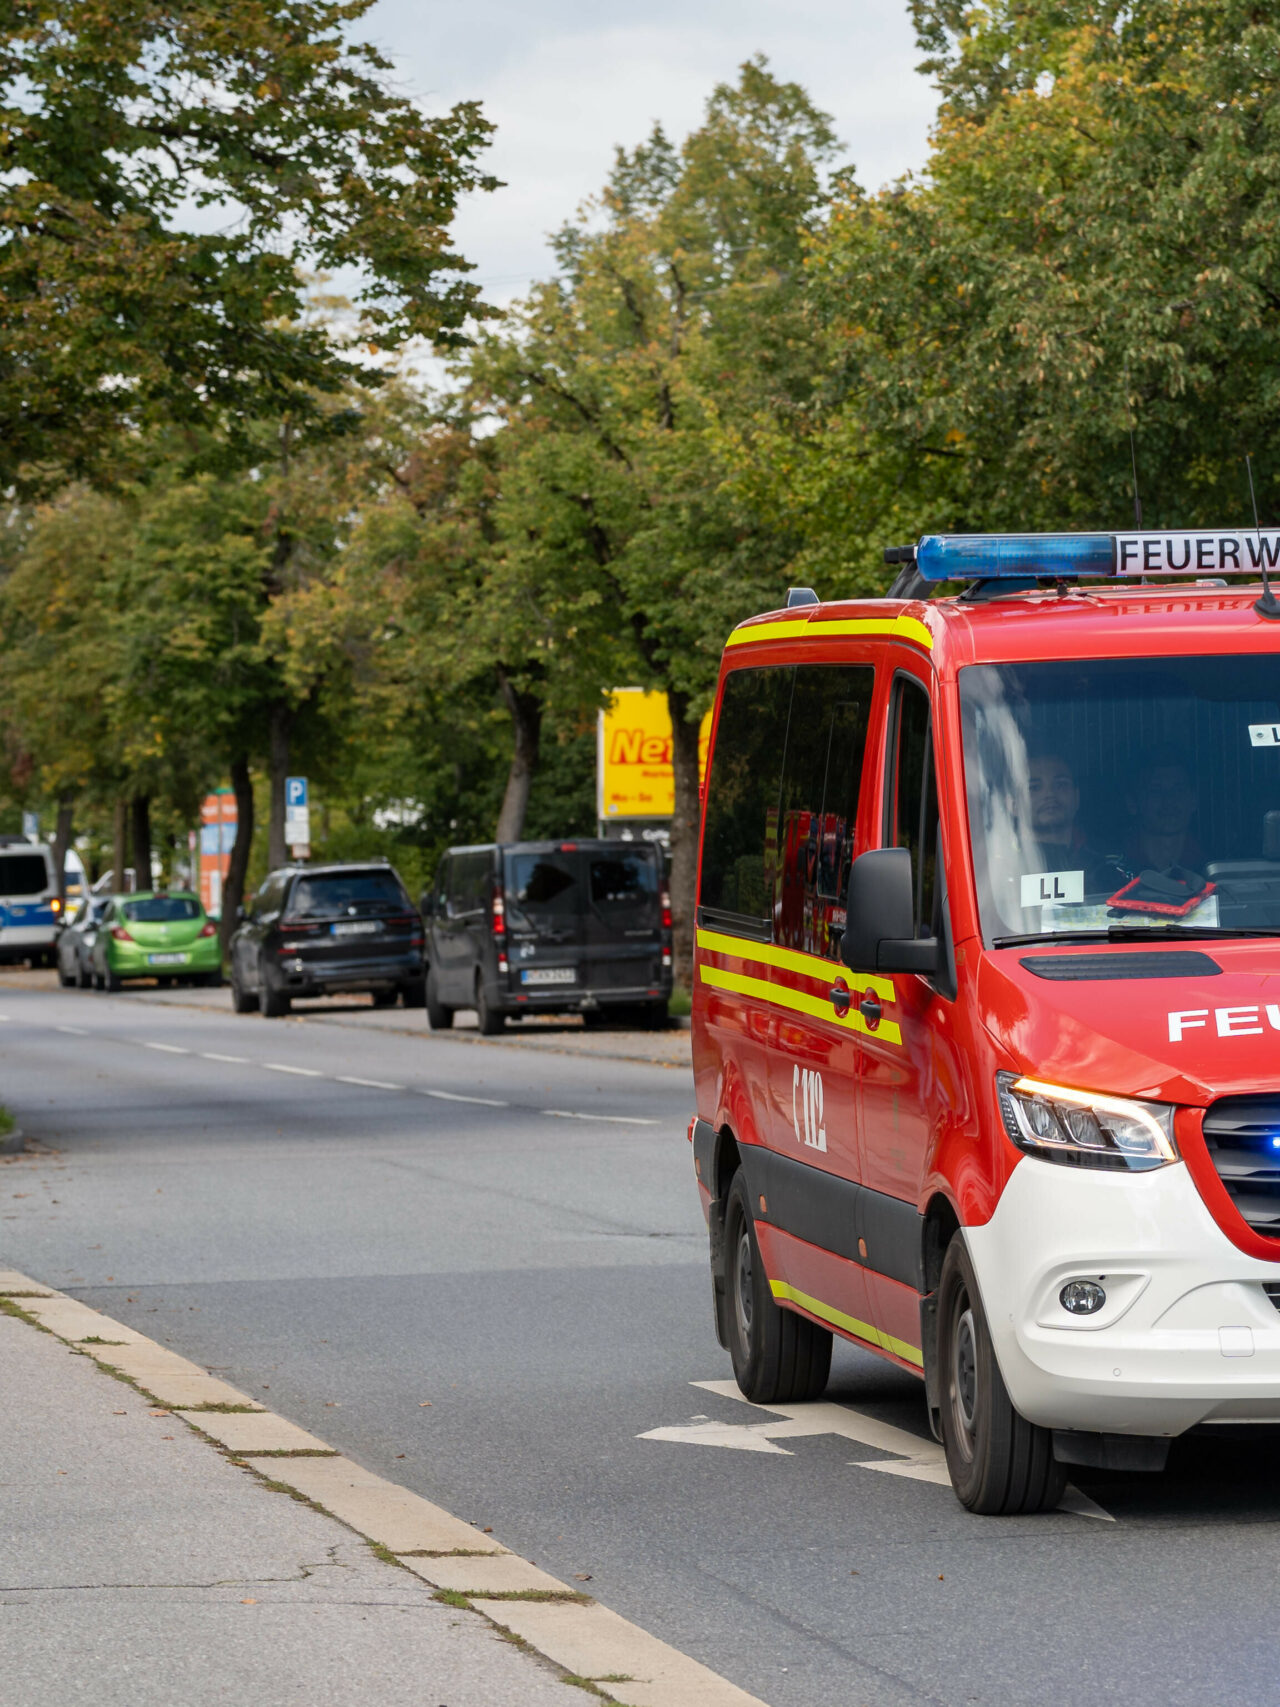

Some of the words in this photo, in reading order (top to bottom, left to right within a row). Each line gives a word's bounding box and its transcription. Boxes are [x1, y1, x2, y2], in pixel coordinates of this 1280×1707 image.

[290, 782, 304, 804] P
[1040, 877, 1065, 899] LL
[802, 1068, 828, 1153] 112
